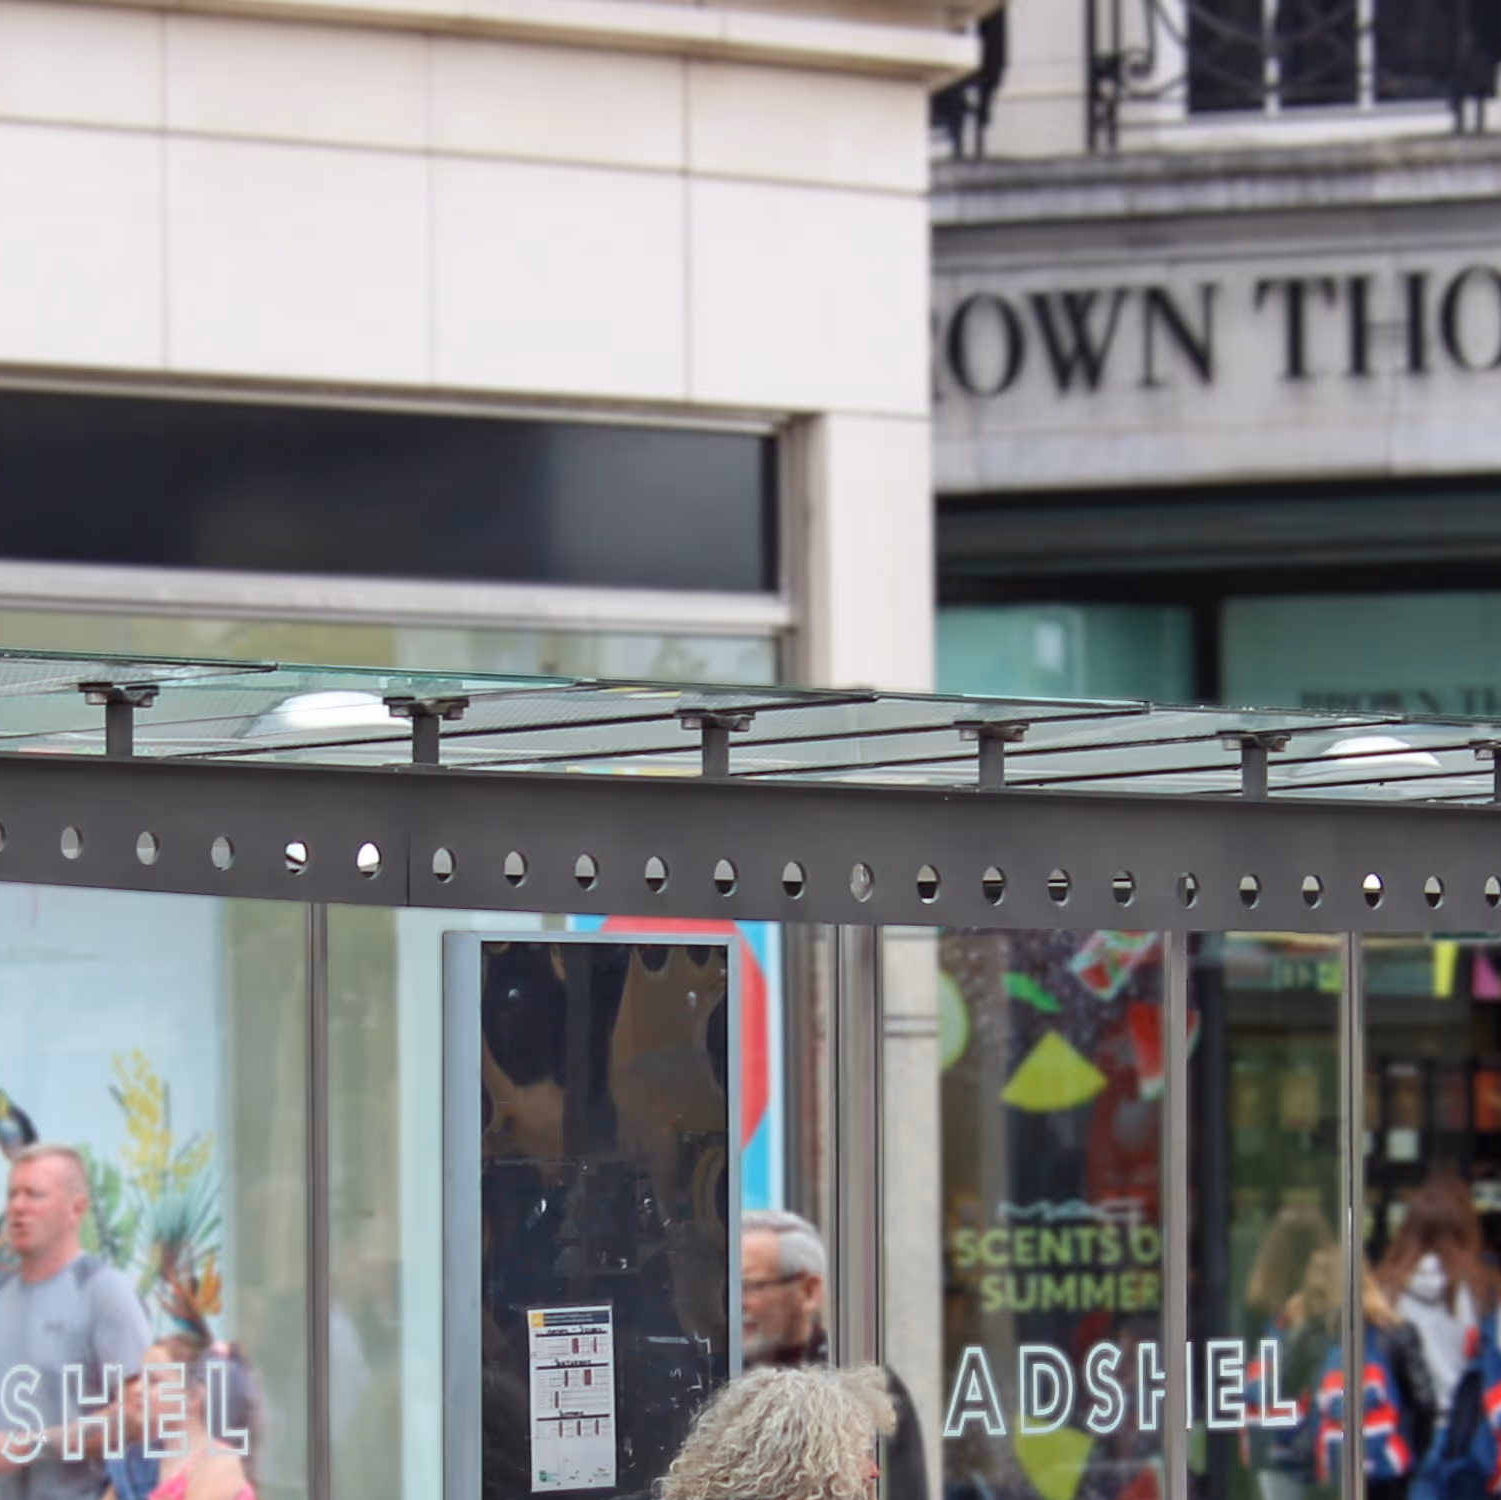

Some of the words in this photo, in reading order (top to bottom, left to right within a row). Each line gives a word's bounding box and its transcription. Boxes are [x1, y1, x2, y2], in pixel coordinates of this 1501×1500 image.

[932, 281, 1221, 398] OWN
[954, 1225, 1122, 1267] SCENTS
[981, 1271, 1161, 1313] SUMMER
[943, 1338, 1298, 1437] ADSHEL
